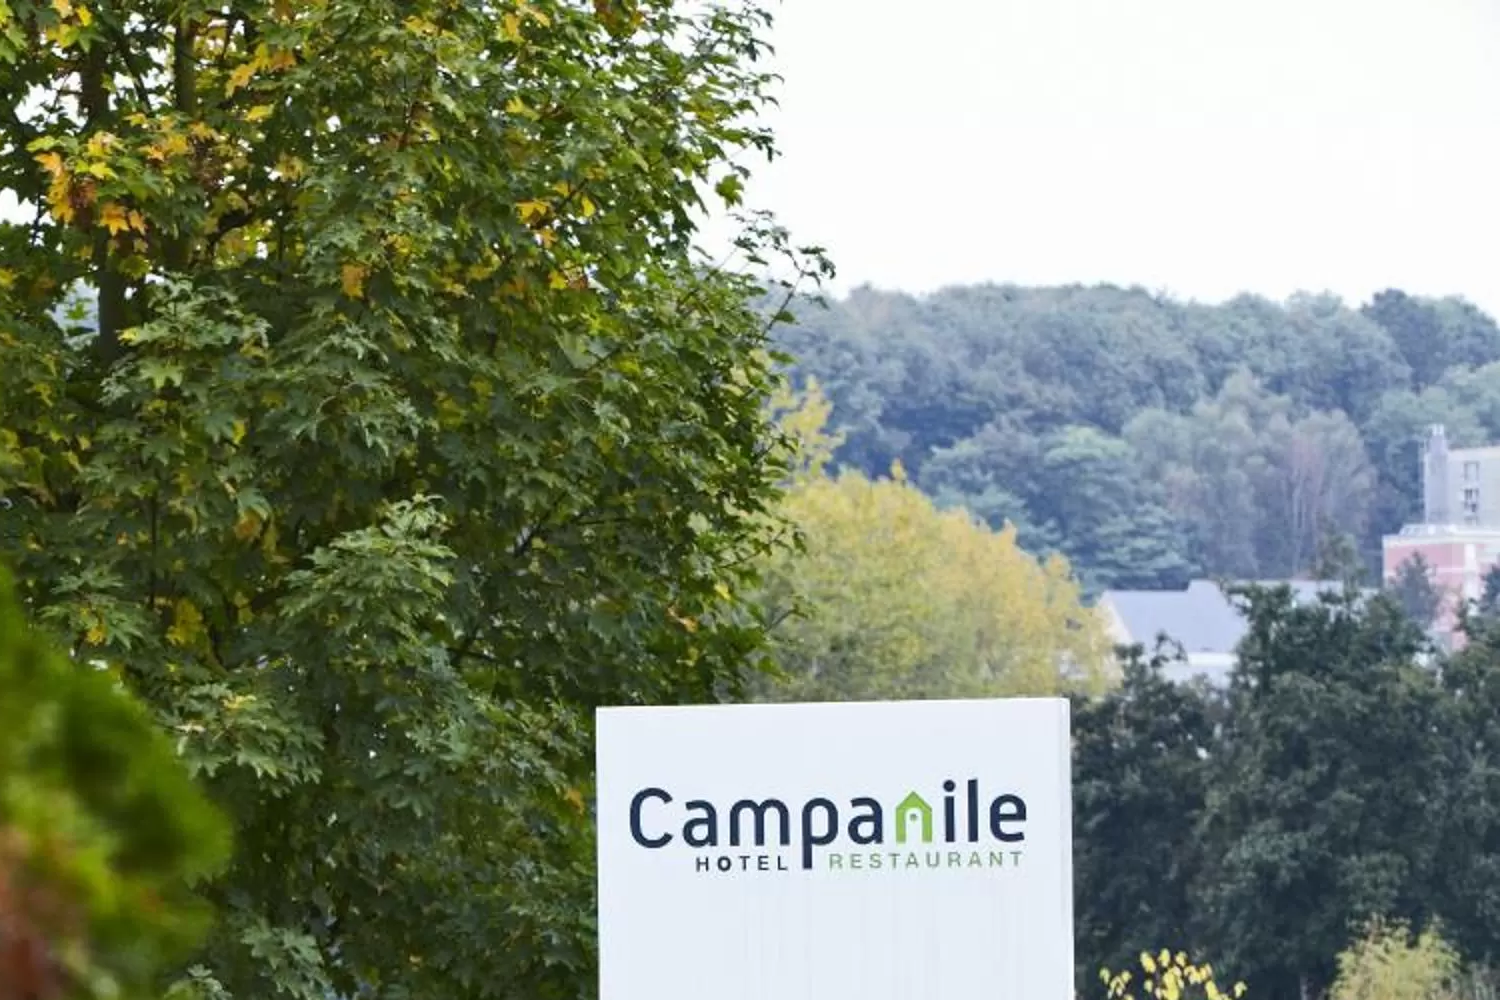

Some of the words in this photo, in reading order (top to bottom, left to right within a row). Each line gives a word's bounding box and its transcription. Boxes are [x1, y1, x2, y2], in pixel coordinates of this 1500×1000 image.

[629, 778, 1028, 870] Campanile
[695, 855, 789, 873] HOTEL
[828, 850, 1025, 870] RESTAURANT
